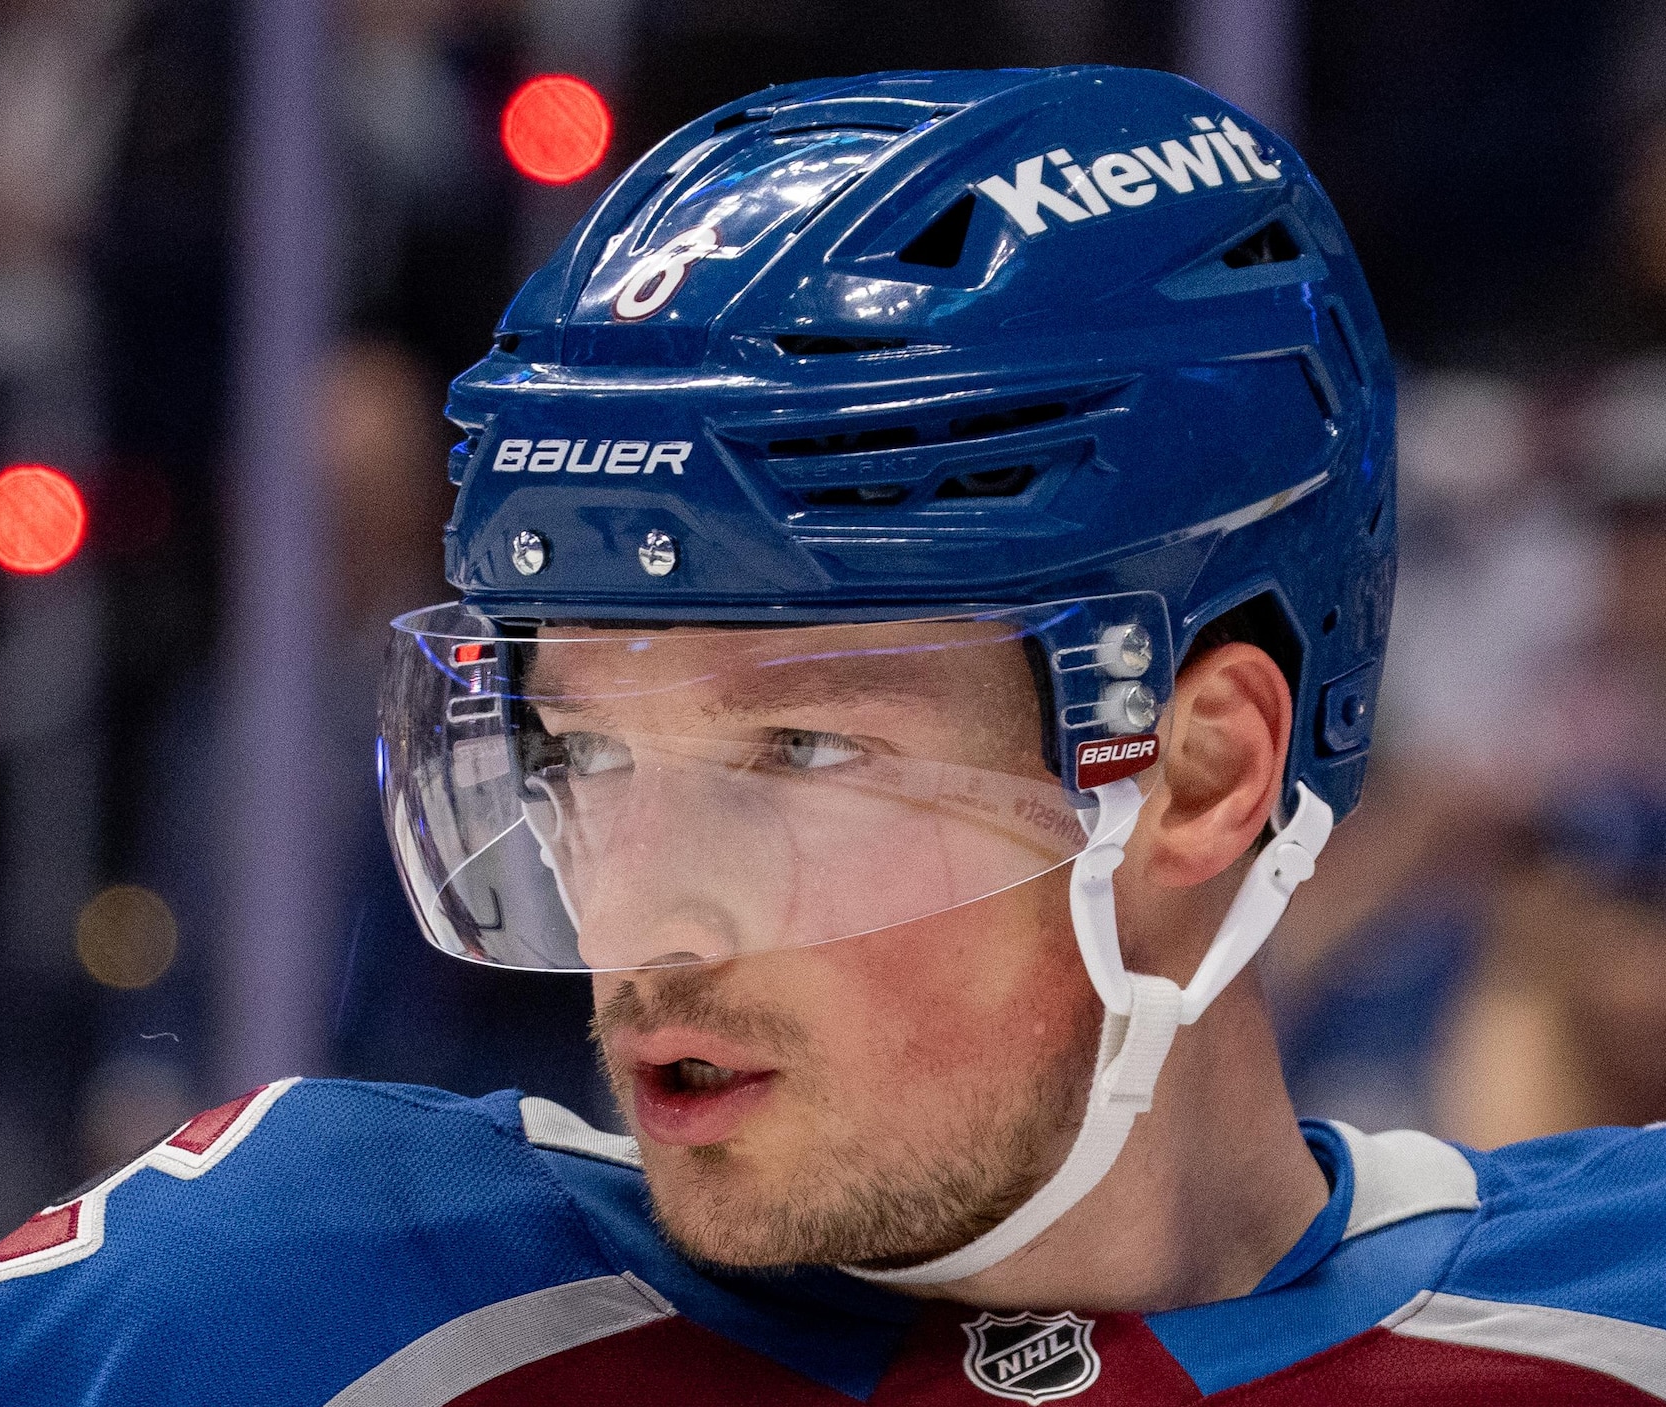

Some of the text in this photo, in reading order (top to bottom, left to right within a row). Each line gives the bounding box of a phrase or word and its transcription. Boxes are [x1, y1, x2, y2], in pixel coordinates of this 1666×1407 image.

[976, 115, 1282, 236] Kiewit
[492, 438, 694, 475] BAUER
[1080, 739, 1156, 765] BAUER
[997, 1333, 1071, 1381] NHL
